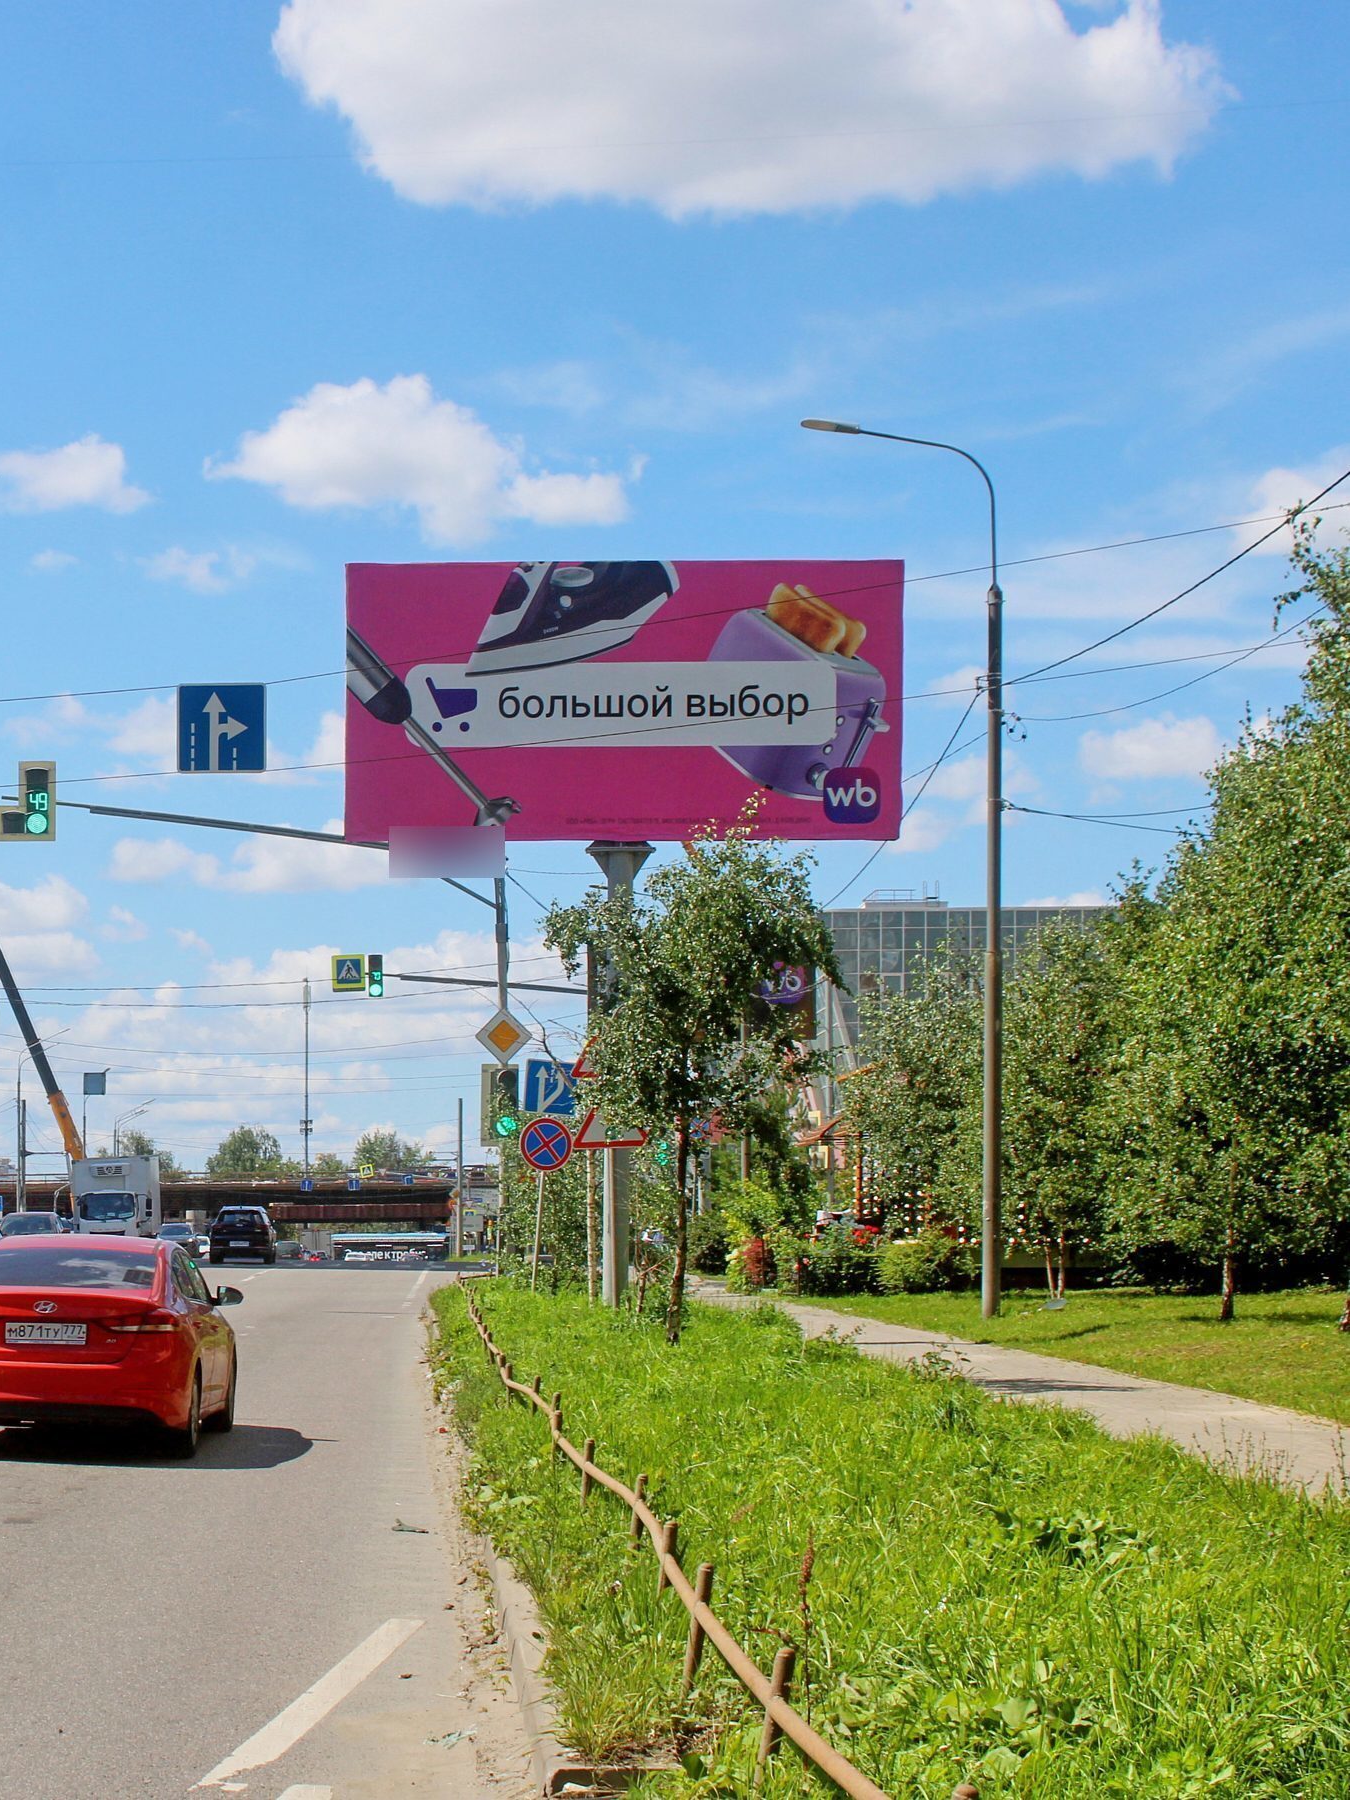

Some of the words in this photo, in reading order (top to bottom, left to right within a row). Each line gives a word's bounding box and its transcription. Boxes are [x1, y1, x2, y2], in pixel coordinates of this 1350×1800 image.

[498, 685, 672, 719] большой
[686, 684, 809, 725] выбор
[29, 792, 48, 811] 49
[826, 778, 877, 807] wb
